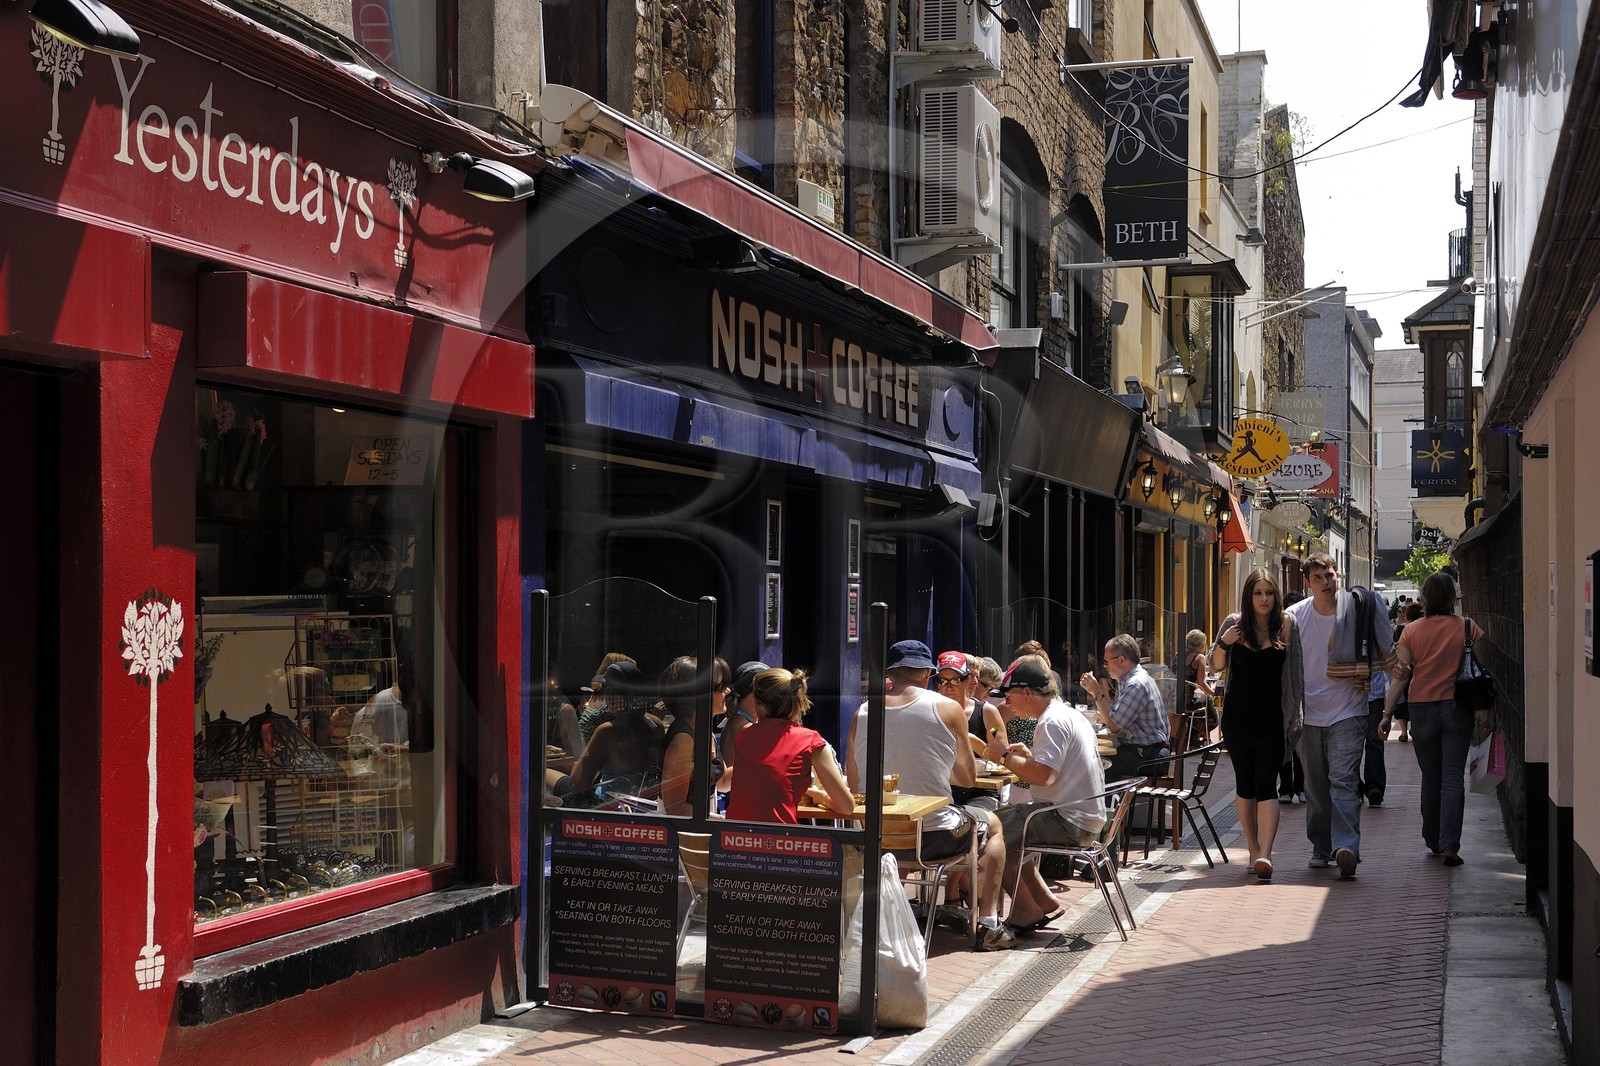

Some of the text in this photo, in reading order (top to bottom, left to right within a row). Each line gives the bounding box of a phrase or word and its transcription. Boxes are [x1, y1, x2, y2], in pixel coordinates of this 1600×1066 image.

[109, 53, 376, 254] Yesterdays
[818, 190, 834, 209] ERIN
[1114, 220, 1179, 244] BETH
[711, 288, 804, 393] NOSH
[831, 337, 919, 428] COFFEE
[1278, 398, 1323, 409] JERRYS
[373, 437, 411, 450] OPEN
[1272, 463, 1323, 478] AZURE
[1414, 478, 1457, 486] VERITAS
[565, 823, 602, 837] NOSH
[614, 827, 664, 840] COFFEE
[724, 835, 762, 849] NOSH
[775, 839, 828, 854] COFFEE
[554, 865, 591, 877] SERVING
[642, 871, 674, 883] LUNCH
[562, 877, 665, 894] & EARLY EVENING MEALS
[712, 878, 751, 891] SERVING
[805, 885, 838, 897] LUNCH
[721, 890, 828, 909] & EARLY EVENING MEALS
[586, 901, 595, 910] IN
[597, 902, 611, 912] OR
[613, 903, 634, 914] TAKE
[635, 905, 659, 916] AWAY
[595, 914, 610, 923] ON
[610, 915, 636, 925] BOTH
[636, 917, 672, 929] FLOORS
[746, 916, 756, 925] IN
[758, 916, 772, 926] OR
[774, 918, 795, 929] TAKE
[796, 920, 822, 931] AWAY
[755, 928, 770, 938] ON
[771, 929, 797, 941] BOTH
[799, 932, 836, 944] FLOORS
